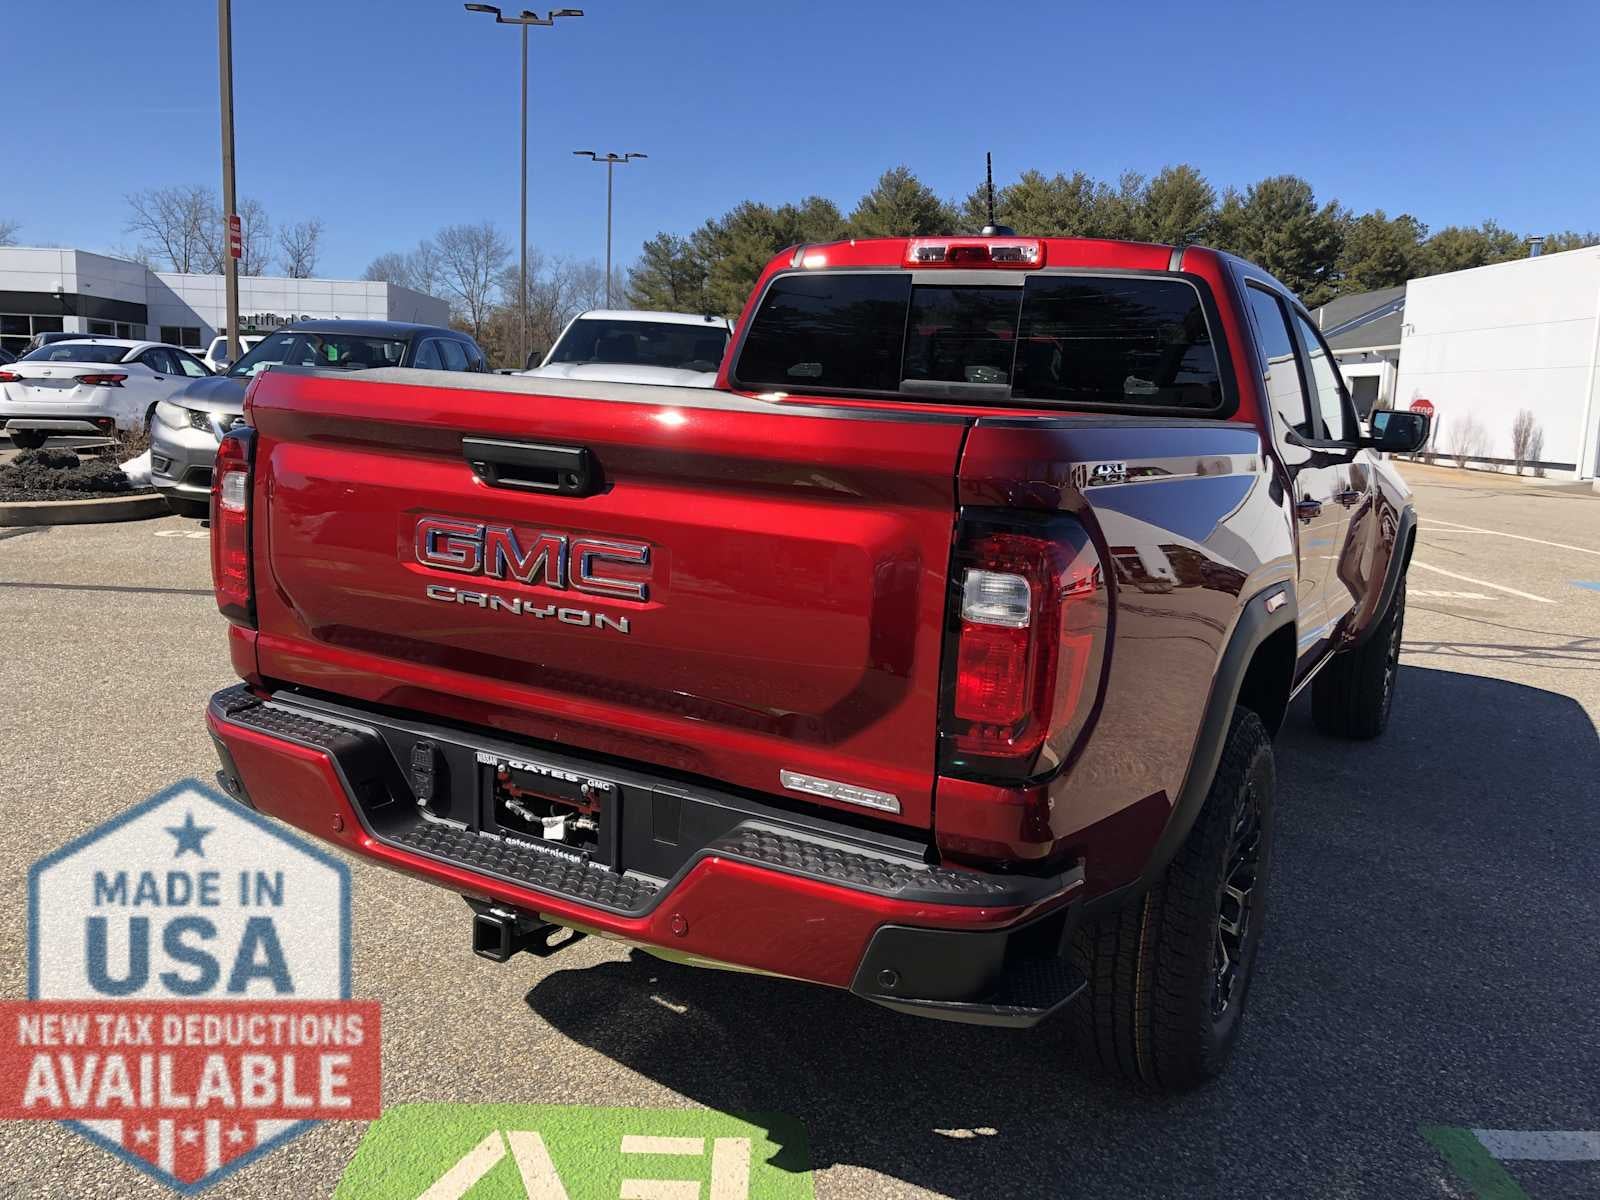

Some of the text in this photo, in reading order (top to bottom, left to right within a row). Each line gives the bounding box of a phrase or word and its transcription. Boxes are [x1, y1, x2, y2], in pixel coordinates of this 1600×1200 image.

[239, 313, 296, 327] ertified
[415, 517, 650, 601] GMC
[426, 583, 631, 634] CANYON
[508, 760, 578, 782] GATES
[587, 778, 610, 791] GMC
